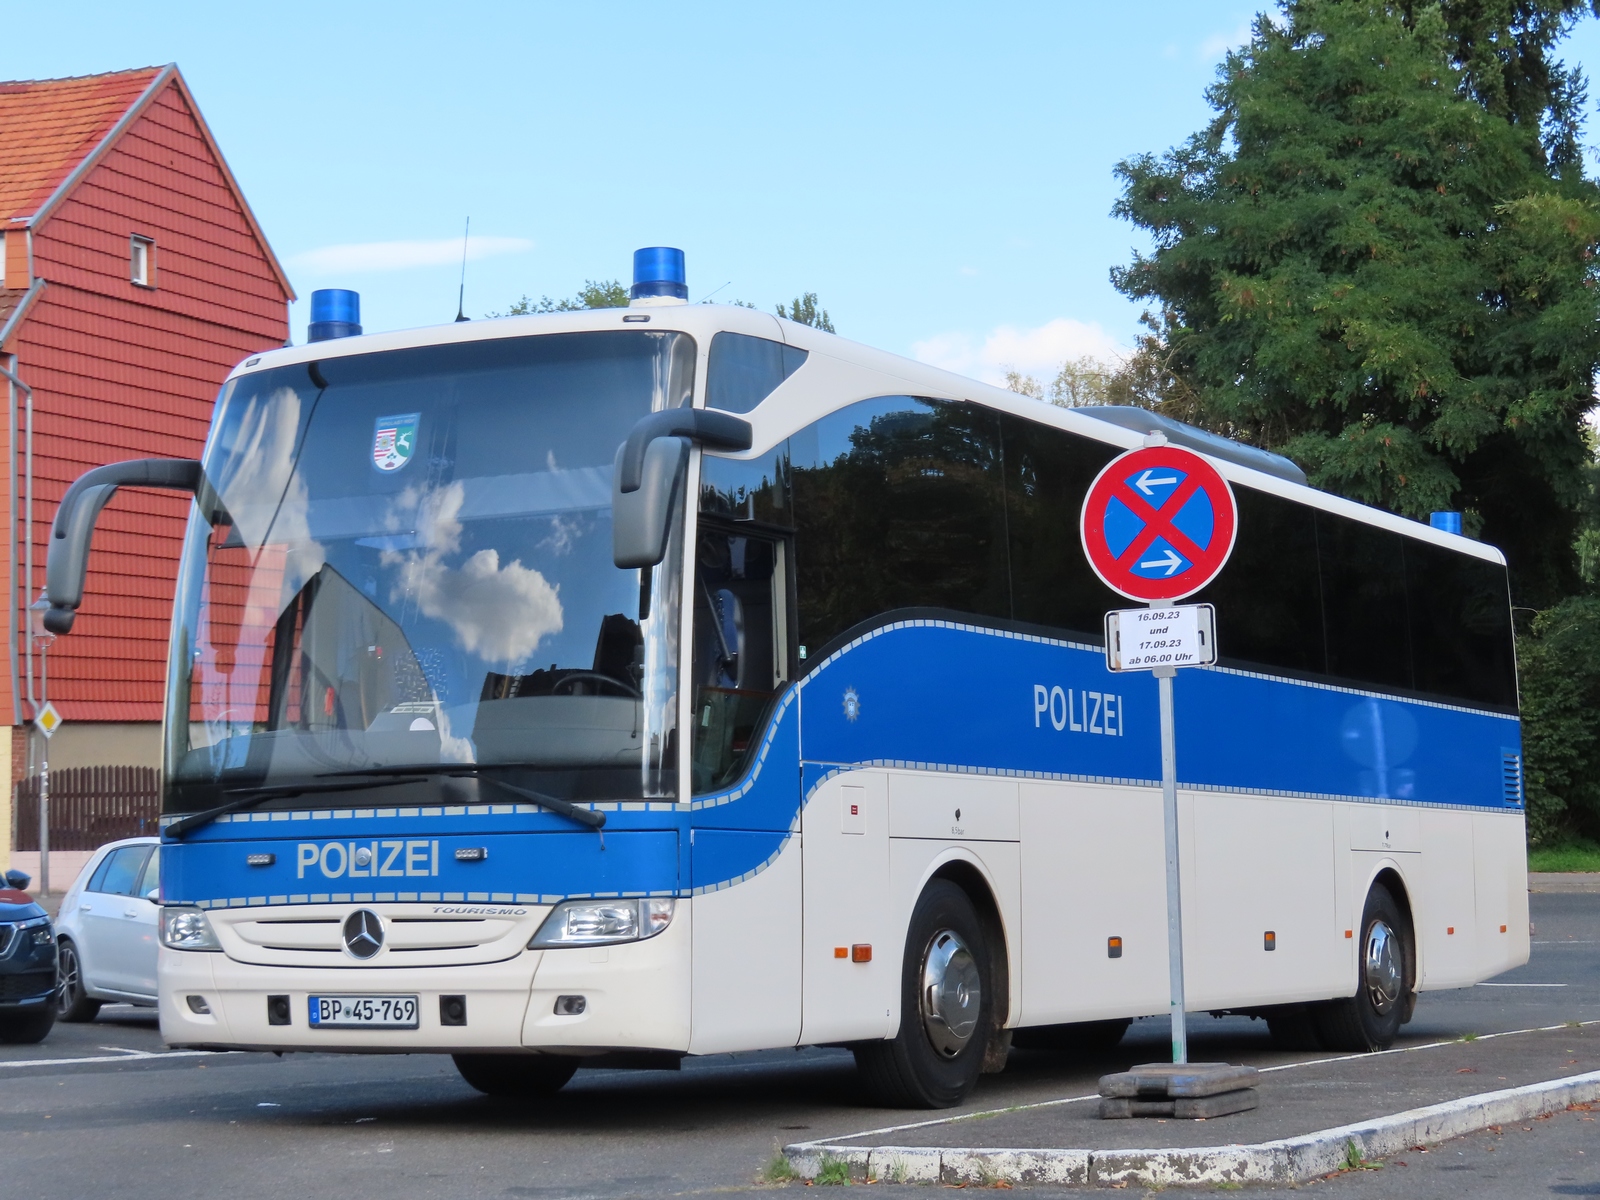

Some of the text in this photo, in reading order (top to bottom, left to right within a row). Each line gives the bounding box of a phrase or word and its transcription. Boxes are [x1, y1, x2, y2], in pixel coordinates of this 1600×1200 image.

[1137, 611, 1180, 622] 16.09.23
[1149, 626, 1169, 635] und
[1139, 639, 1182, 650] 17.09.23
[1128, 653, 1193, 665] ab 06.00 Uhr
[1033, 684, 1123, 737] POLIZEI
[297, 840, 439, 879] POLIZEI
[433, 907, 528, 916] TOURISMO
[320, 999, 342, 1020] BP
[352, 999, 415, 1021] 45-769
